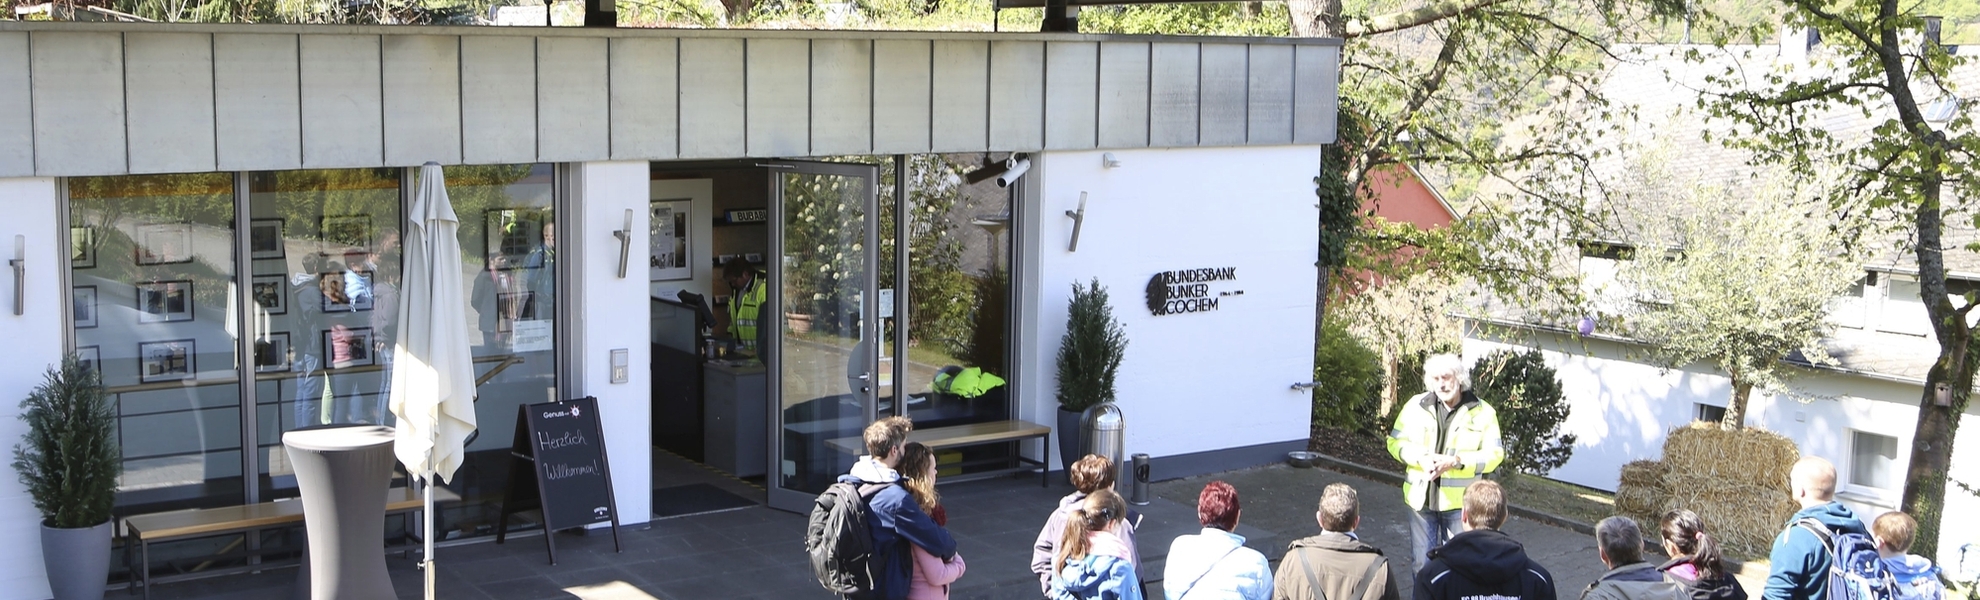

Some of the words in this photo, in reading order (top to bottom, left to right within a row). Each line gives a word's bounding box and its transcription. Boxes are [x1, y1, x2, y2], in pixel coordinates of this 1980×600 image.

[1166, 266, 1236, 284] BUNDESBANK
[1166, 283, 1208, 299] BUNKER
[1165, 297, 1218, 314] COCHEM
[543, 411, 564, 419] Genuss
[538, 429, 587, 451] Herzlich
[543, 459, 600, 480] Willkommen!
